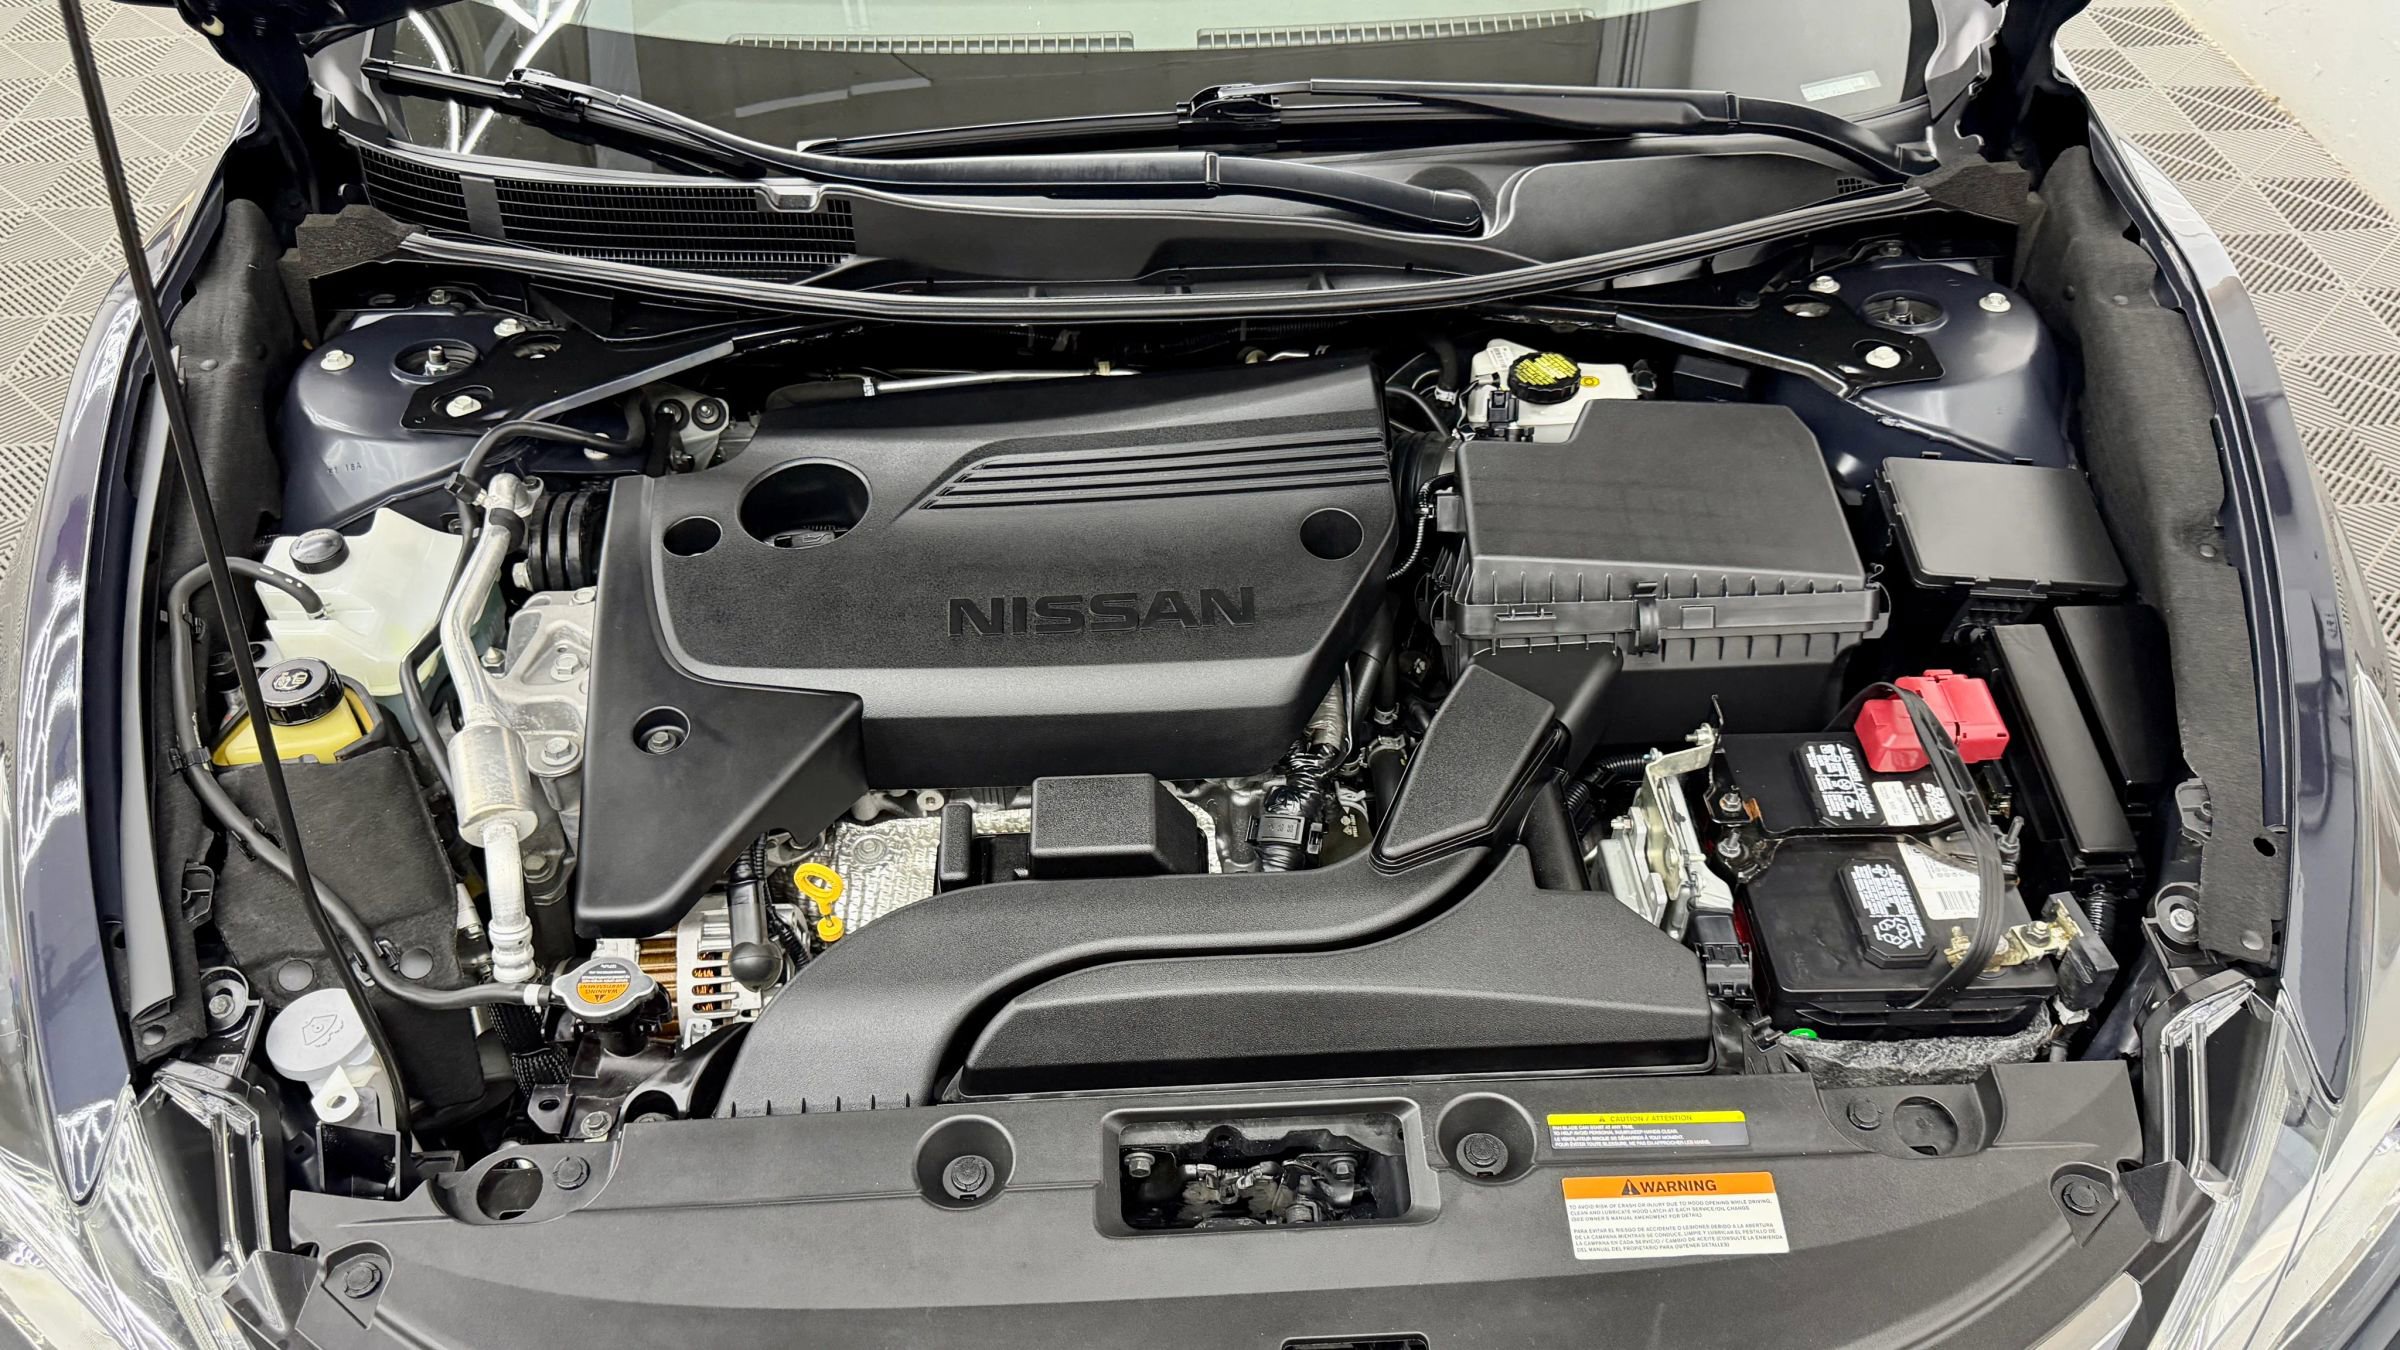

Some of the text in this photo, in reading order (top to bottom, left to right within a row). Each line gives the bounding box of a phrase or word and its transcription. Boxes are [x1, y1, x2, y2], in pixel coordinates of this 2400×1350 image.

[948, 587, 1254, 637] NISSAN
[1844, 754, 1863, 781] DANGER
[1856, 788, 1877, 814] POISON
[1640, 1180, 1717, 1193] WARNING
